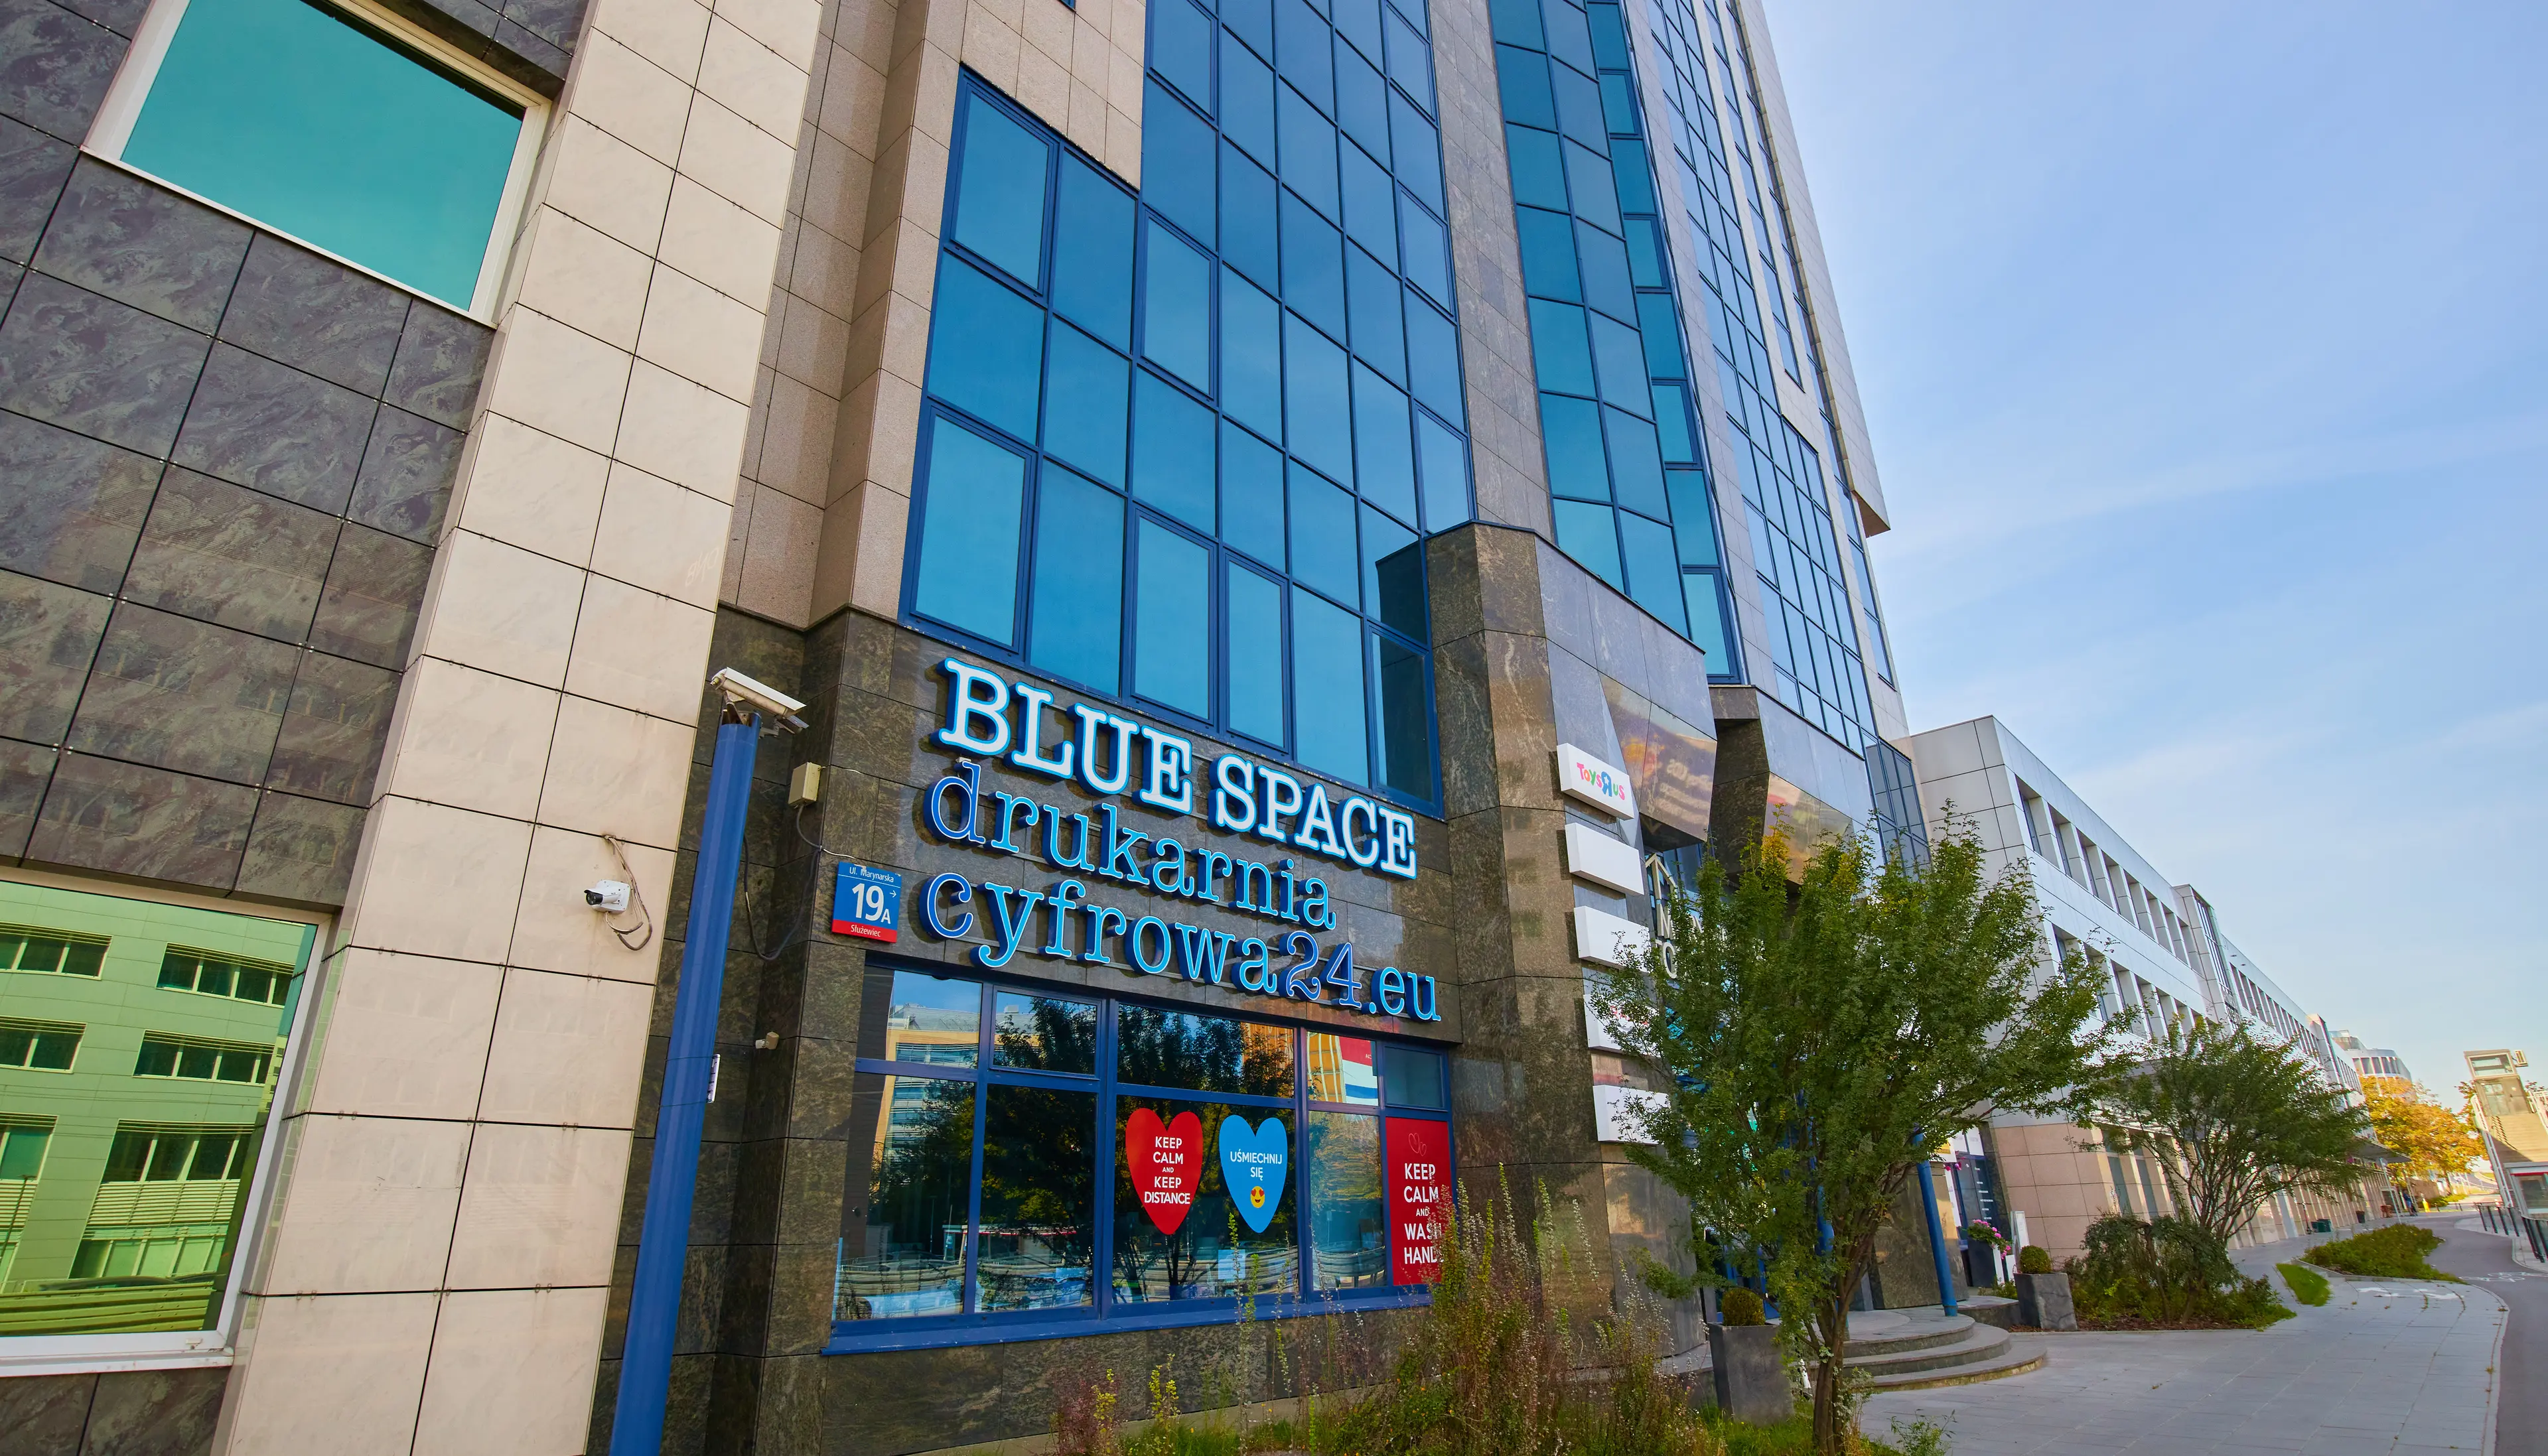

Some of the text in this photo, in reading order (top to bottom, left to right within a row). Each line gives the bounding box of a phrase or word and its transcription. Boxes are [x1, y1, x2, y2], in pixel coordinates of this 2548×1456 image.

[935, 657, 1418, 880] BLUE SPACE
[928, 759, 1336, 931] drukarnia
[860, 868, 894, 883] Marynarska
[851, 924, 881, 937] Służewiec
[923, 872, 1442, 1022] cyfrowa24.eu
[1155, 1136, 1182, 1149] KEEP
[1153, 1152, 1184, 1165] CALM
[1230, 1149, 1283, 1165] UŚMIECHNIJ
[1250, 1166, 1263, 1181] SIĘ
[1404, 1163, 1436, 1181] KEEP
[1154, 1176, 1182, 1189] KEEP
[1144, 1191, 1190, 1205] DISTANCE
[1403, 1186, 1439, 1203] CALM
[1415, 1208, 1430, 1217] AND
[1404, 1223, 1442, 1240] WASH
